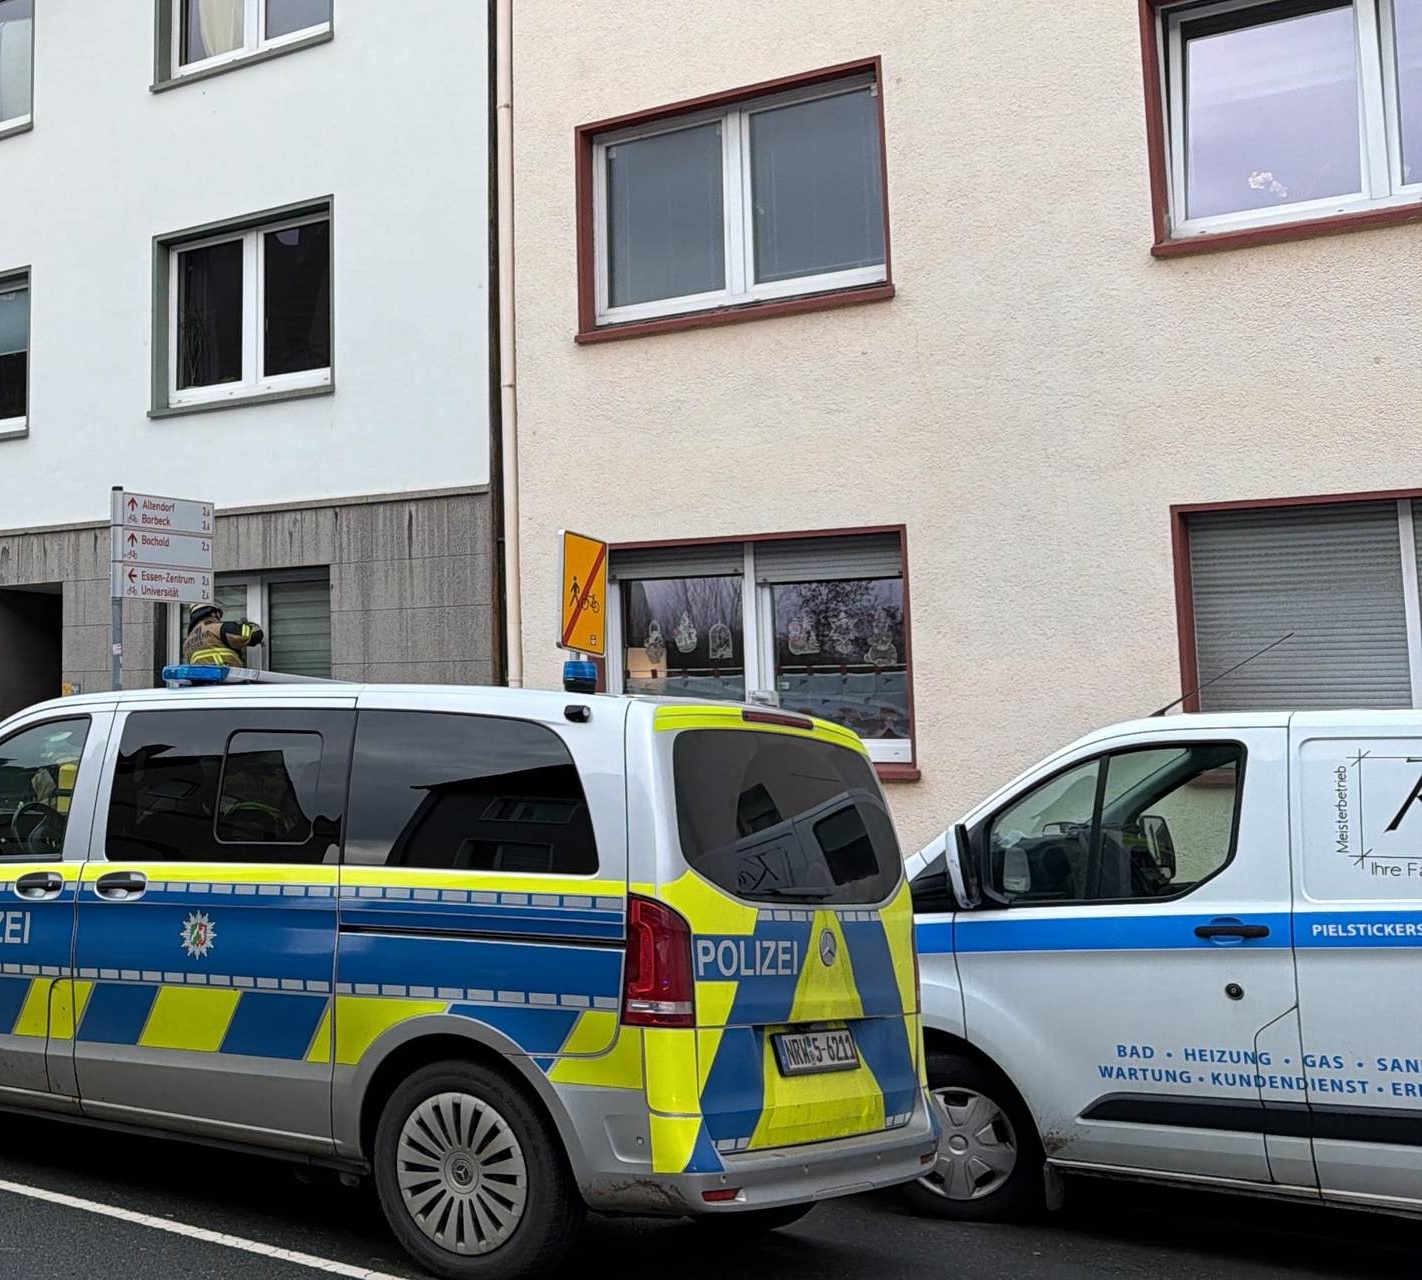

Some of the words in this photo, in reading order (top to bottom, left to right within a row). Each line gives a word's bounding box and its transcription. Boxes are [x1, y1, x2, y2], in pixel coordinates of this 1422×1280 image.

[142, 499, 175, 513] Altendorf
[141, 513, 171, 527] Borbeck
[141, 535, 170, 548] Bochold
[141, 571, 195, 585] Essen-Zentrum
[141, 586, 179, 598] Universität
[1333, 765, 1350, 853] Meisterbetrieb
[1371, 862, 1402, 877] Ihre
[696, 939, 798, 977] POLIZEI
[1116, 1044, 1155, 1059] BAD
[1183, 1047, 1272, 1066] HEIZUNG
[1303, 1054, 1344, 1069] GAS
[1098, 1065, 1192, 1084] WARTUNG
[1211, 1071, 1369, 1095] KUNDENDIENST
